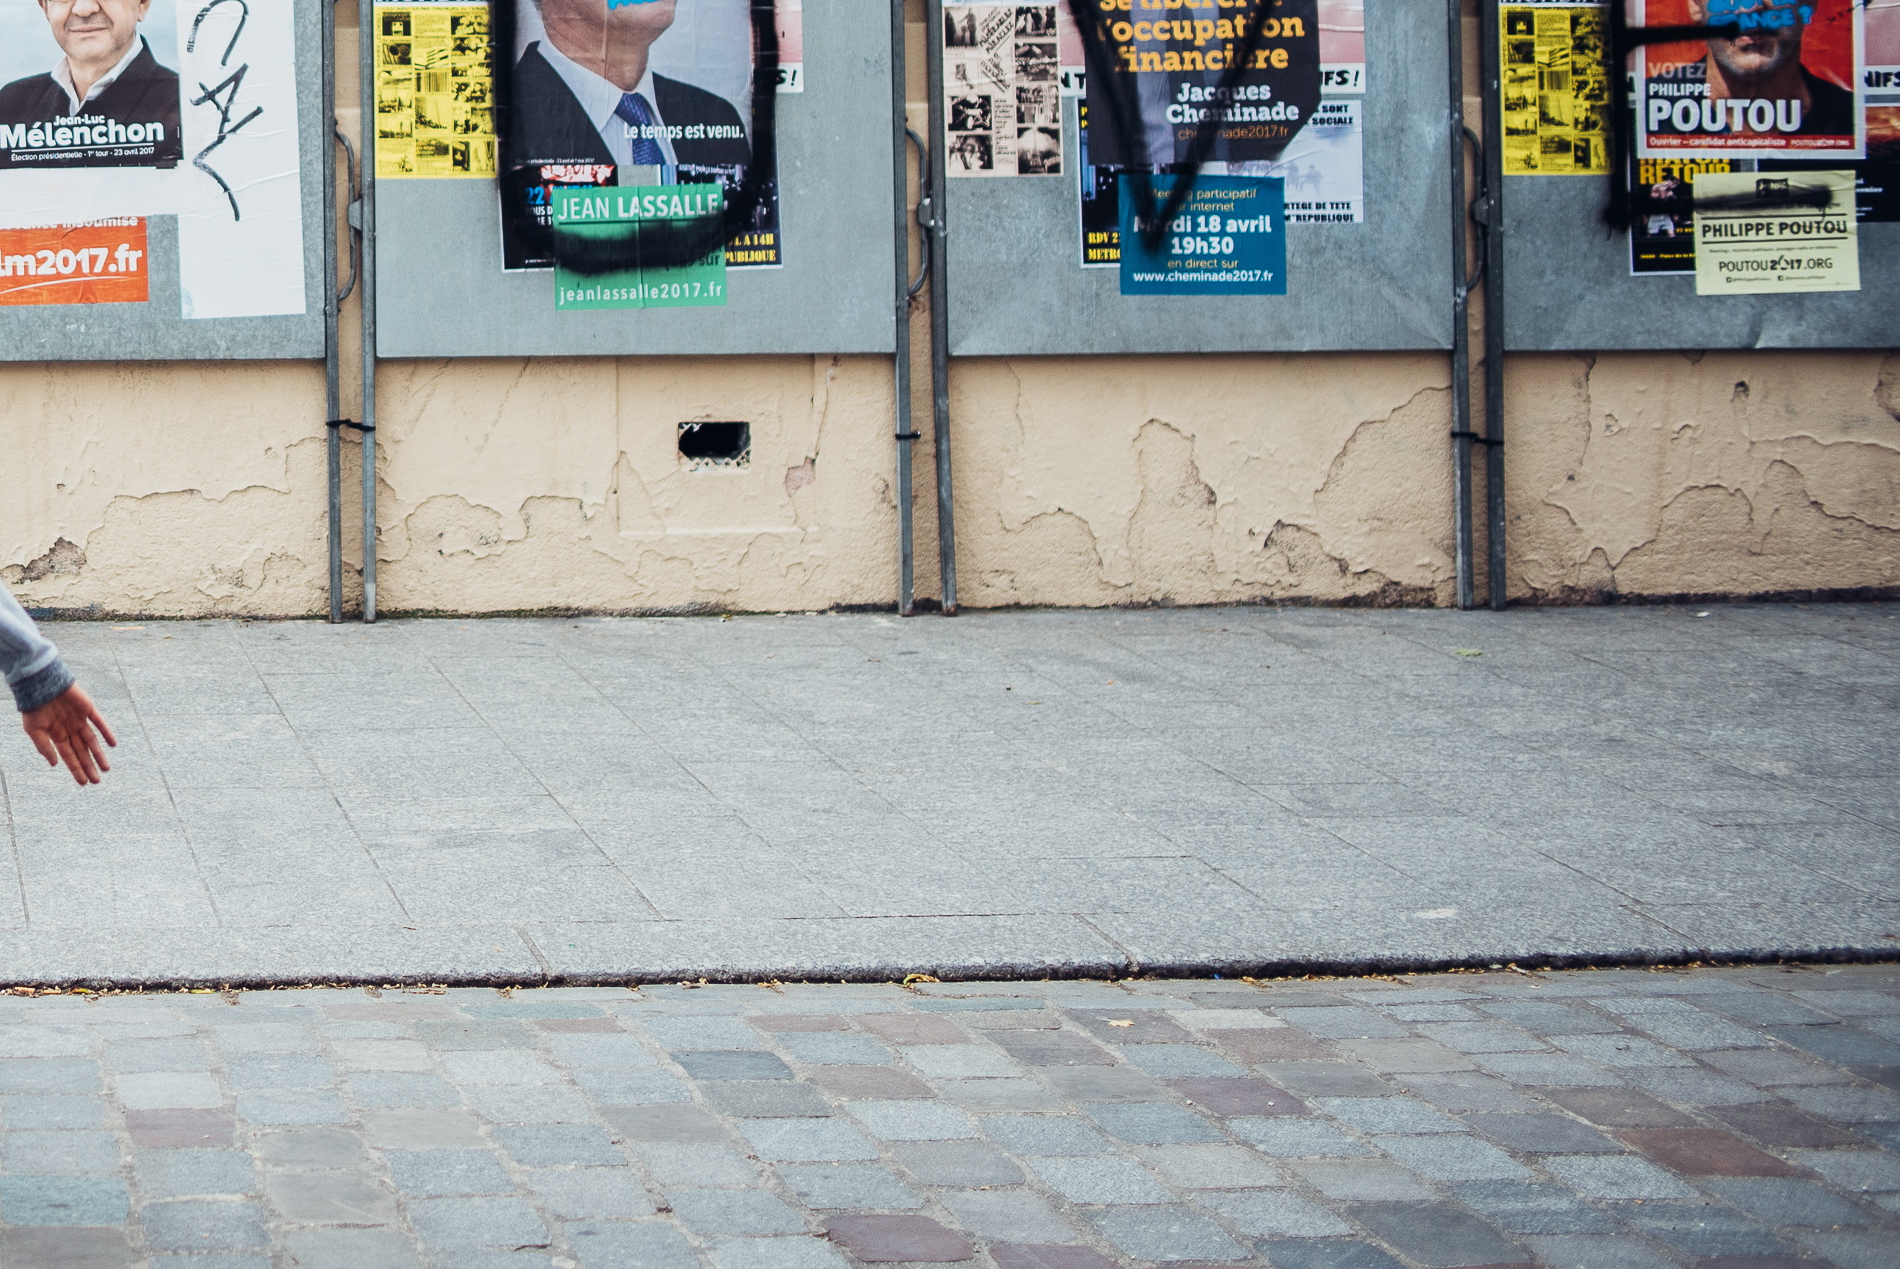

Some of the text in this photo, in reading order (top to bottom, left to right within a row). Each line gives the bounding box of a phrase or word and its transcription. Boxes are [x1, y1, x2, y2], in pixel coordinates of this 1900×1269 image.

[1649, 62, 1706, 79] VOTEZ
[1649, 82, 1712, 97] PHILIPPE
[53, 114, 105, 127] Jean-Luc
[1649, 98, 1801, 132] POUTOU
[0, 119, 165, 149] Mélenchon
[624, 123, 745, 143] Le temps est venu.
[1196, 188, 1258, 201] participatif
[558, 193, 719, 220] JEAN LASSALLE
[1190, 201, 1235, 212] internet
[1197, 215, 1272, 233] 18 avril
[1702, 220, 1848, 238] PHILIPPE POUTOU
[1171, 237, 1235, 254] 19h30
[1167, 258, 1239, 269] en direct sur
[1133, 270, 1273, 283] www.cheminade2017.fr
[559, 281, 723, 305] jeanlassalle2017.fr
